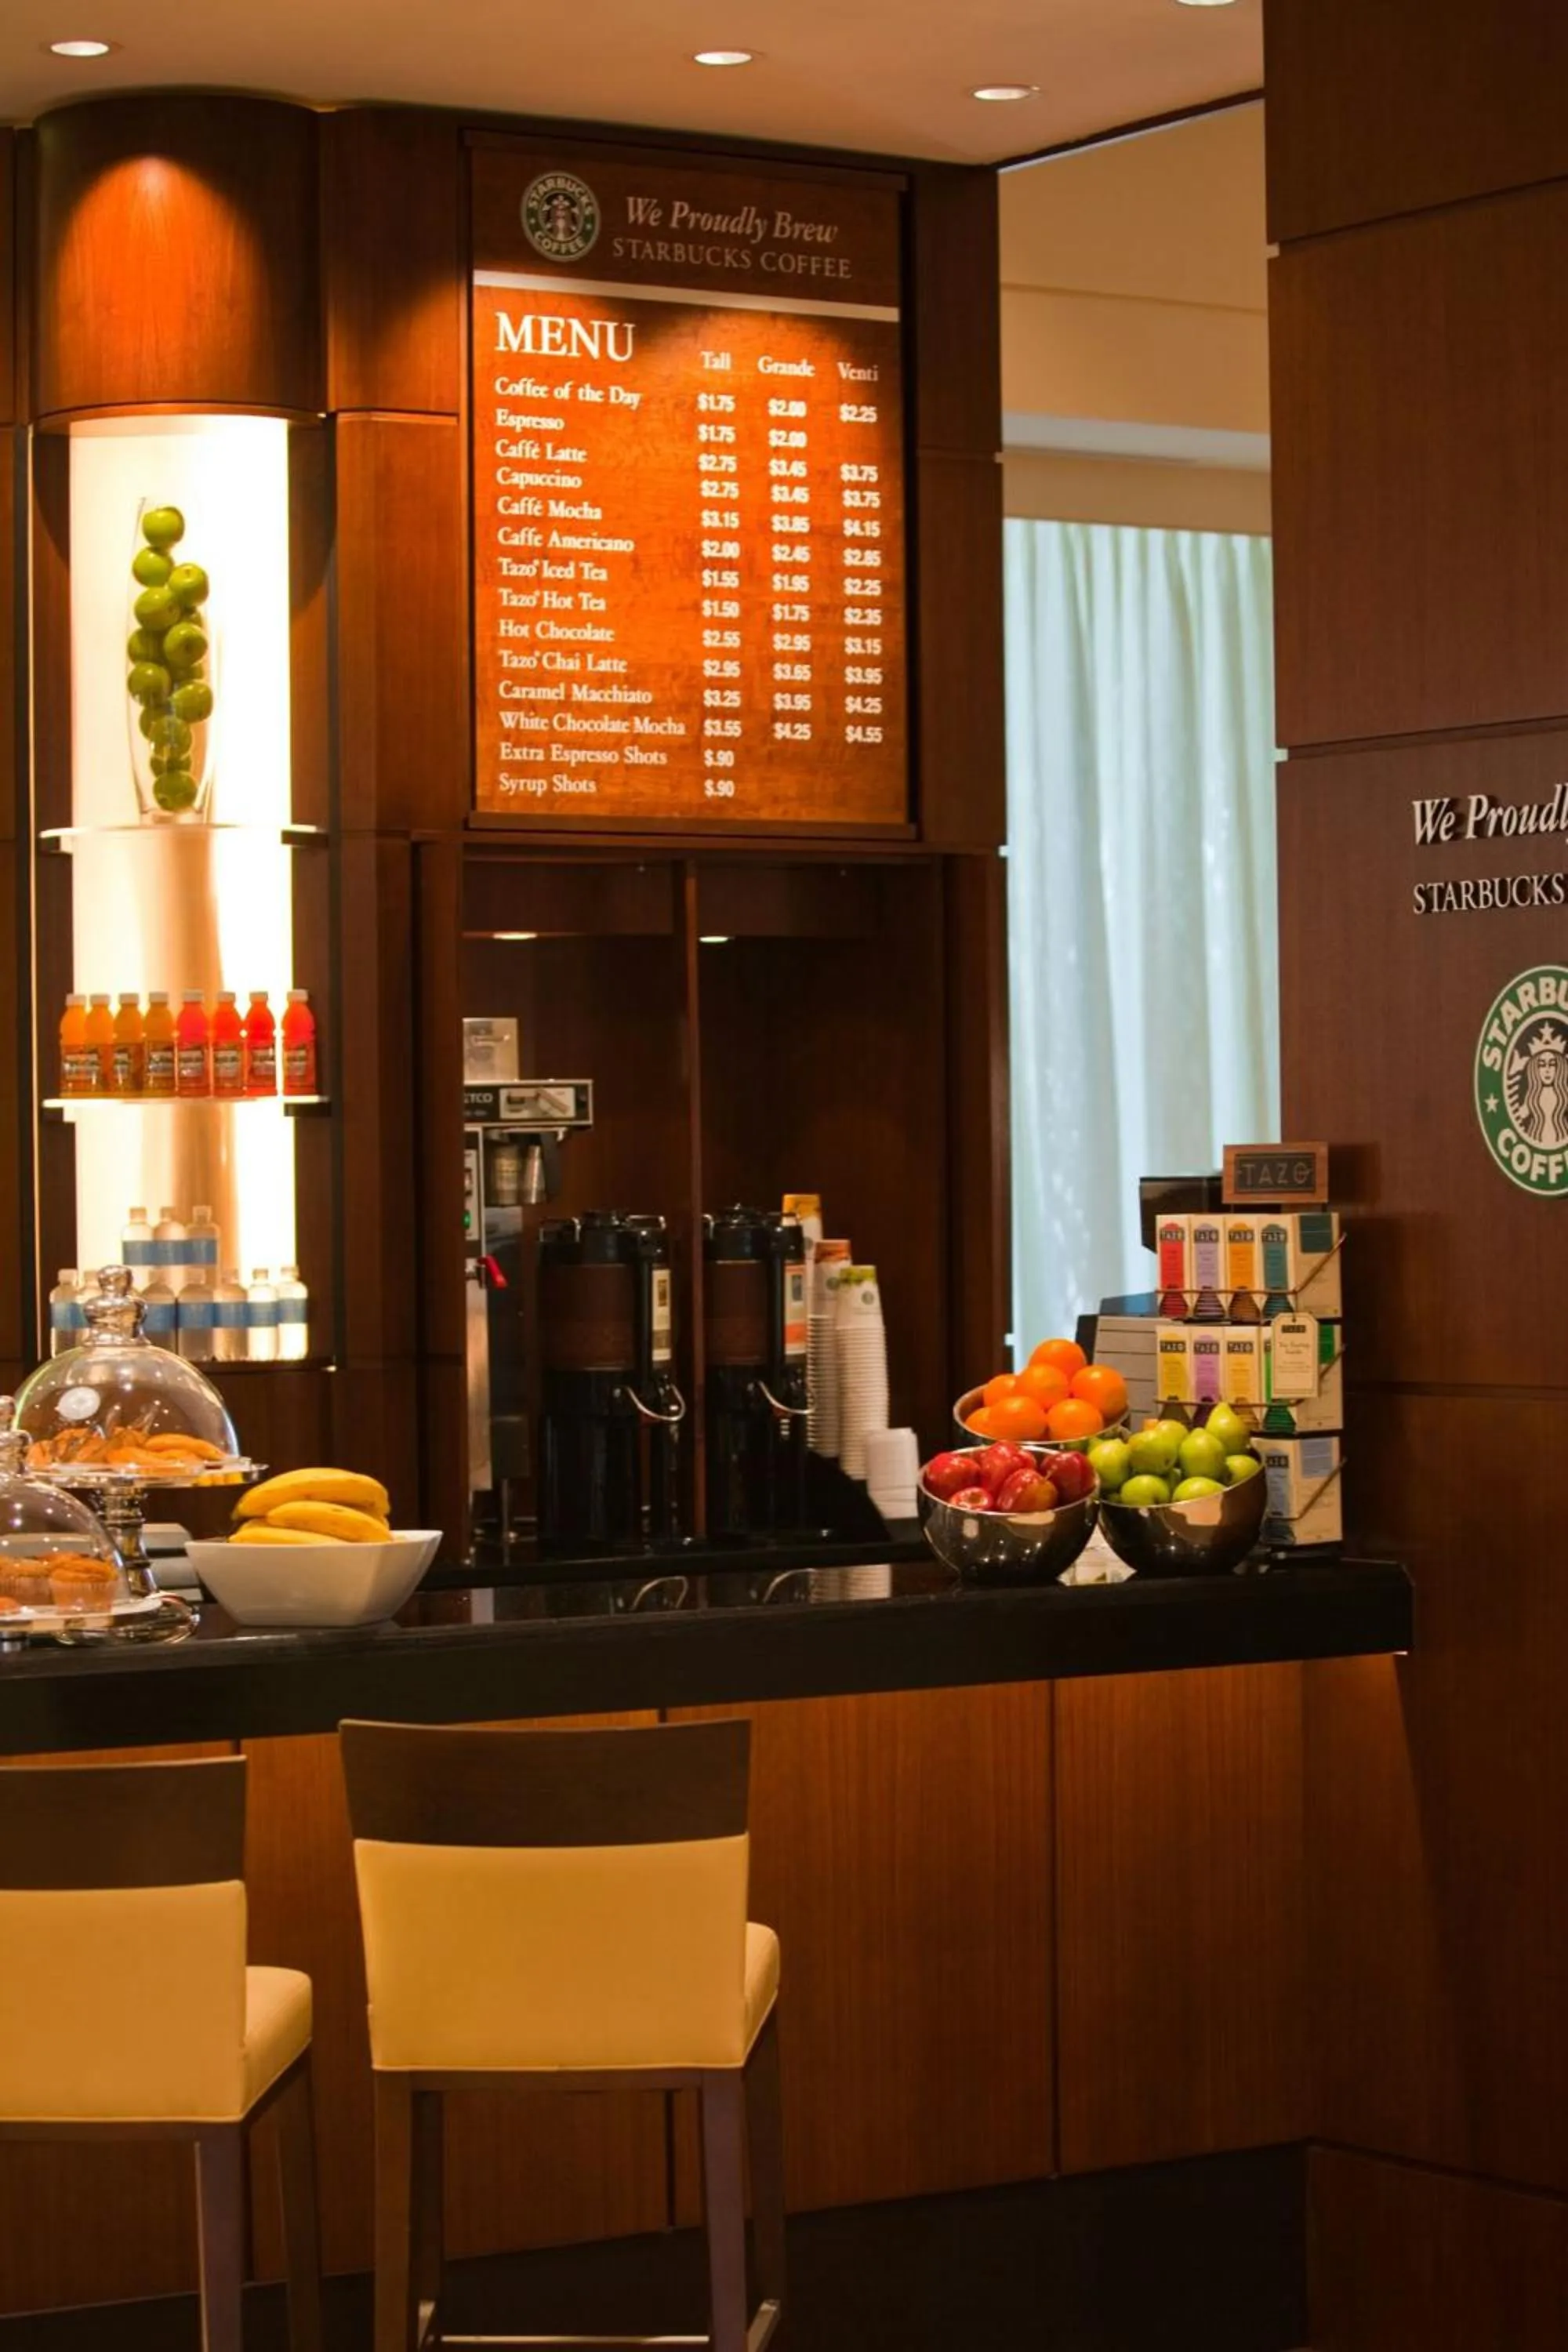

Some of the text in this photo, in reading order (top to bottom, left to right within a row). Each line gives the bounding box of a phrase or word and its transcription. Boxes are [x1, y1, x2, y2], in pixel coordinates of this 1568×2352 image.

[528, 176, 593, 216] STARBUCKS
[626, 196, 839, 245] We Proudly Brew
[534, 230, 585, 254] COFFEE
[612, 237, 852, 279] STARBUCKS COFFEE
[495, 311, 636, 362] MENU
[701, 351, 879, 382] Tall Grande Venti
[494, 376, 642, 410] Coffee of the Day
[696, 392, 736, 413] $1.75
[495, 407, 565, 433] Espresso
[697, 423, 736, 444] $1.75
[546, 441, 588, 463] Latte
[697, 452, 738, 473] $2.75
[495, 466, 583, 490] Capuccino
[699, 479, 740, 499] $2.75
[547, 499, 603, 521] Mocha
[700, 508, 740, 529] $3.15
[547, 528, 635, 553] Americano
[542, 559, 575, 580] Iced
[579, 561, 608, 582] Tea
[542, 590, 574, 610] Hot
[578, 591, 607, 612] Tea
[771, 602, 811, 622] $1.75
[499, 618, 615, 643] Hot Chocolate
[542, 651, 581, 671] Chai
[586, 652, 628, 673] Latte
[498, 679, 653, 705] Caramel Macchiato
[702, 688, 742, 708] $3.25
[499, 710, 686, 735] White Chocolate Mocha
[499, 742, 668, 767] Extra Espresso Shots
[499, 772, 597, 797] Syrup Shots
[1412, 782, 1568, 845] We Proudl
[1413, 872, 1565, 915] STARBUCKS
[1497, 1128, 1568, 1184] COFF
[1241, 1162, 1312, 1185] TAZO
